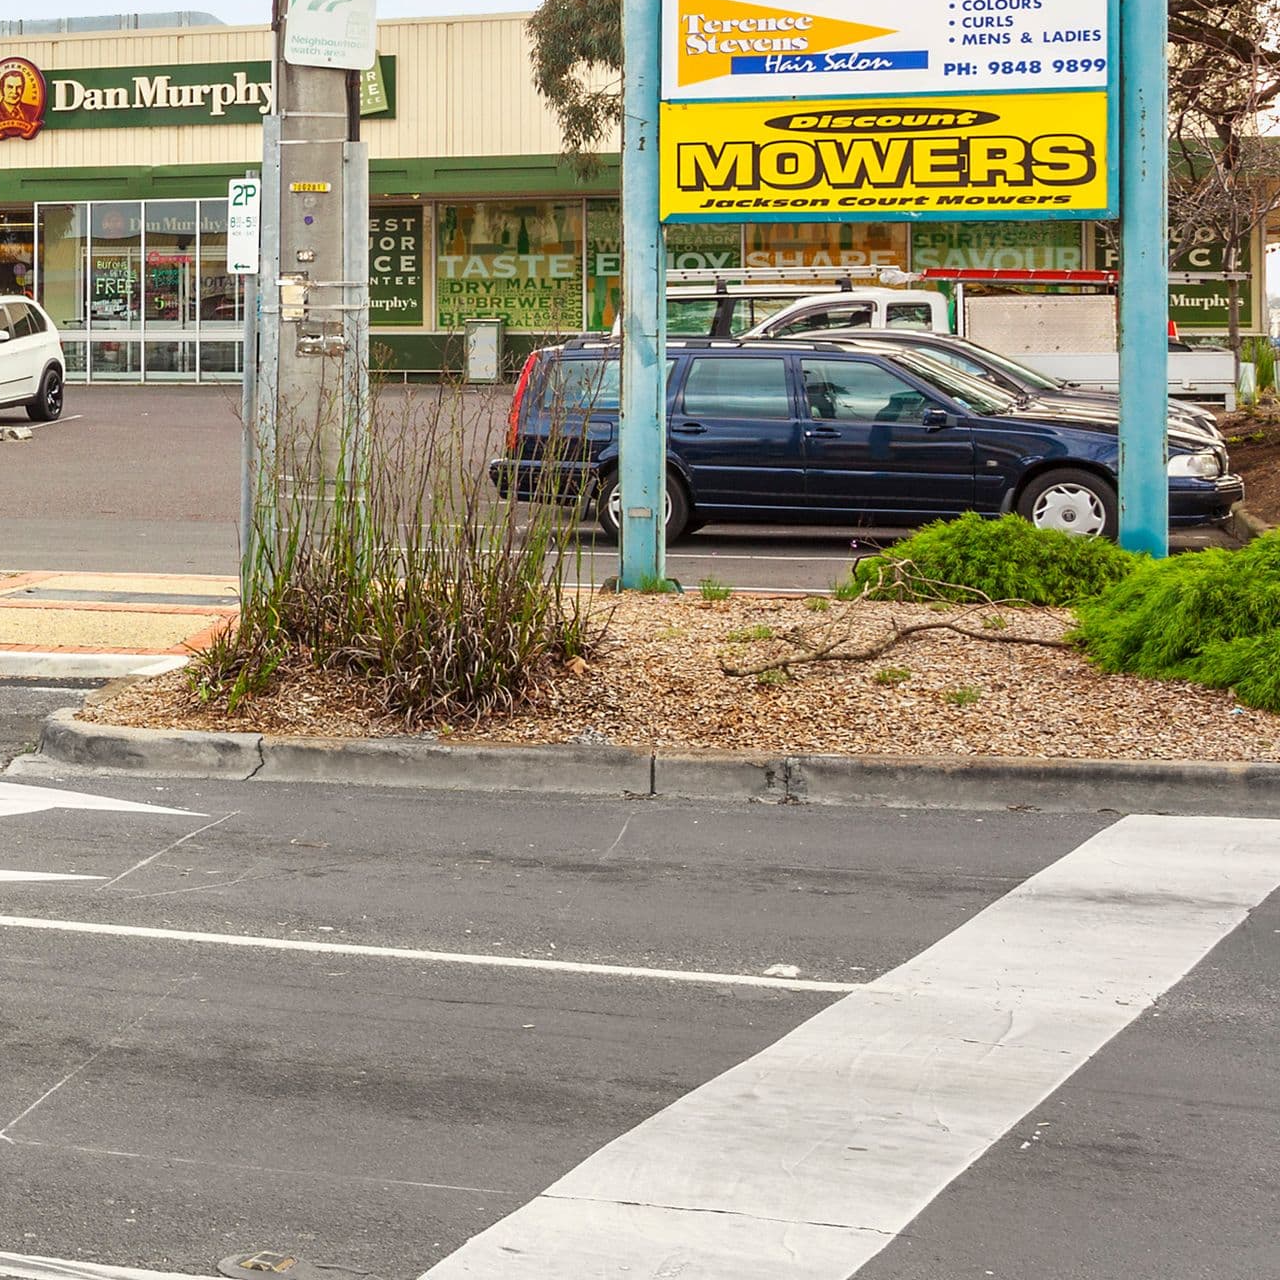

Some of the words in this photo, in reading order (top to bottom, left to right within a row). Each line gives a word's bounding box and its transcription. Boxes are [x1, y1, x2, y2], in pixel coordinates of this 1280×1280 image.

[682, 13, 814, 36] Terence
[962, 15, 1015, 29] CURLS
[685, 32, 809, 56] Stevens
[962, 32, 1012, 47] MENS
[1020, 31, 1033, 44] &
[1042, 29, 1102, 44] LADIES
[764, 52, 817, 73] Hair
[823, 50, 893, 71] Salon
[943, 61, 978, 77] PH:
[988, 59, 1042, 75] 9848
[1053, 57, 1107, 73] 9899
[52, 80, 130, 112] Dan
[788, 109, 978, 131] Discount
[677, 134, 1097, 192] MOWERS
[233, 185, 256, 206] 2P
[699, 197, 830, 209] Jackson
[838, 195, 930, 207] Court
[936, 193, 1072, 206] Mowers
[439, 254, 575, 277] TASTE
[915, 246, 1081, 270] SAVOUR
[96, 277, 136, 295] FREE
[450, 281, 494, 293] DRY
[506, 278, 566, 289] MALT
[441, 297, 475, 305] MILD
